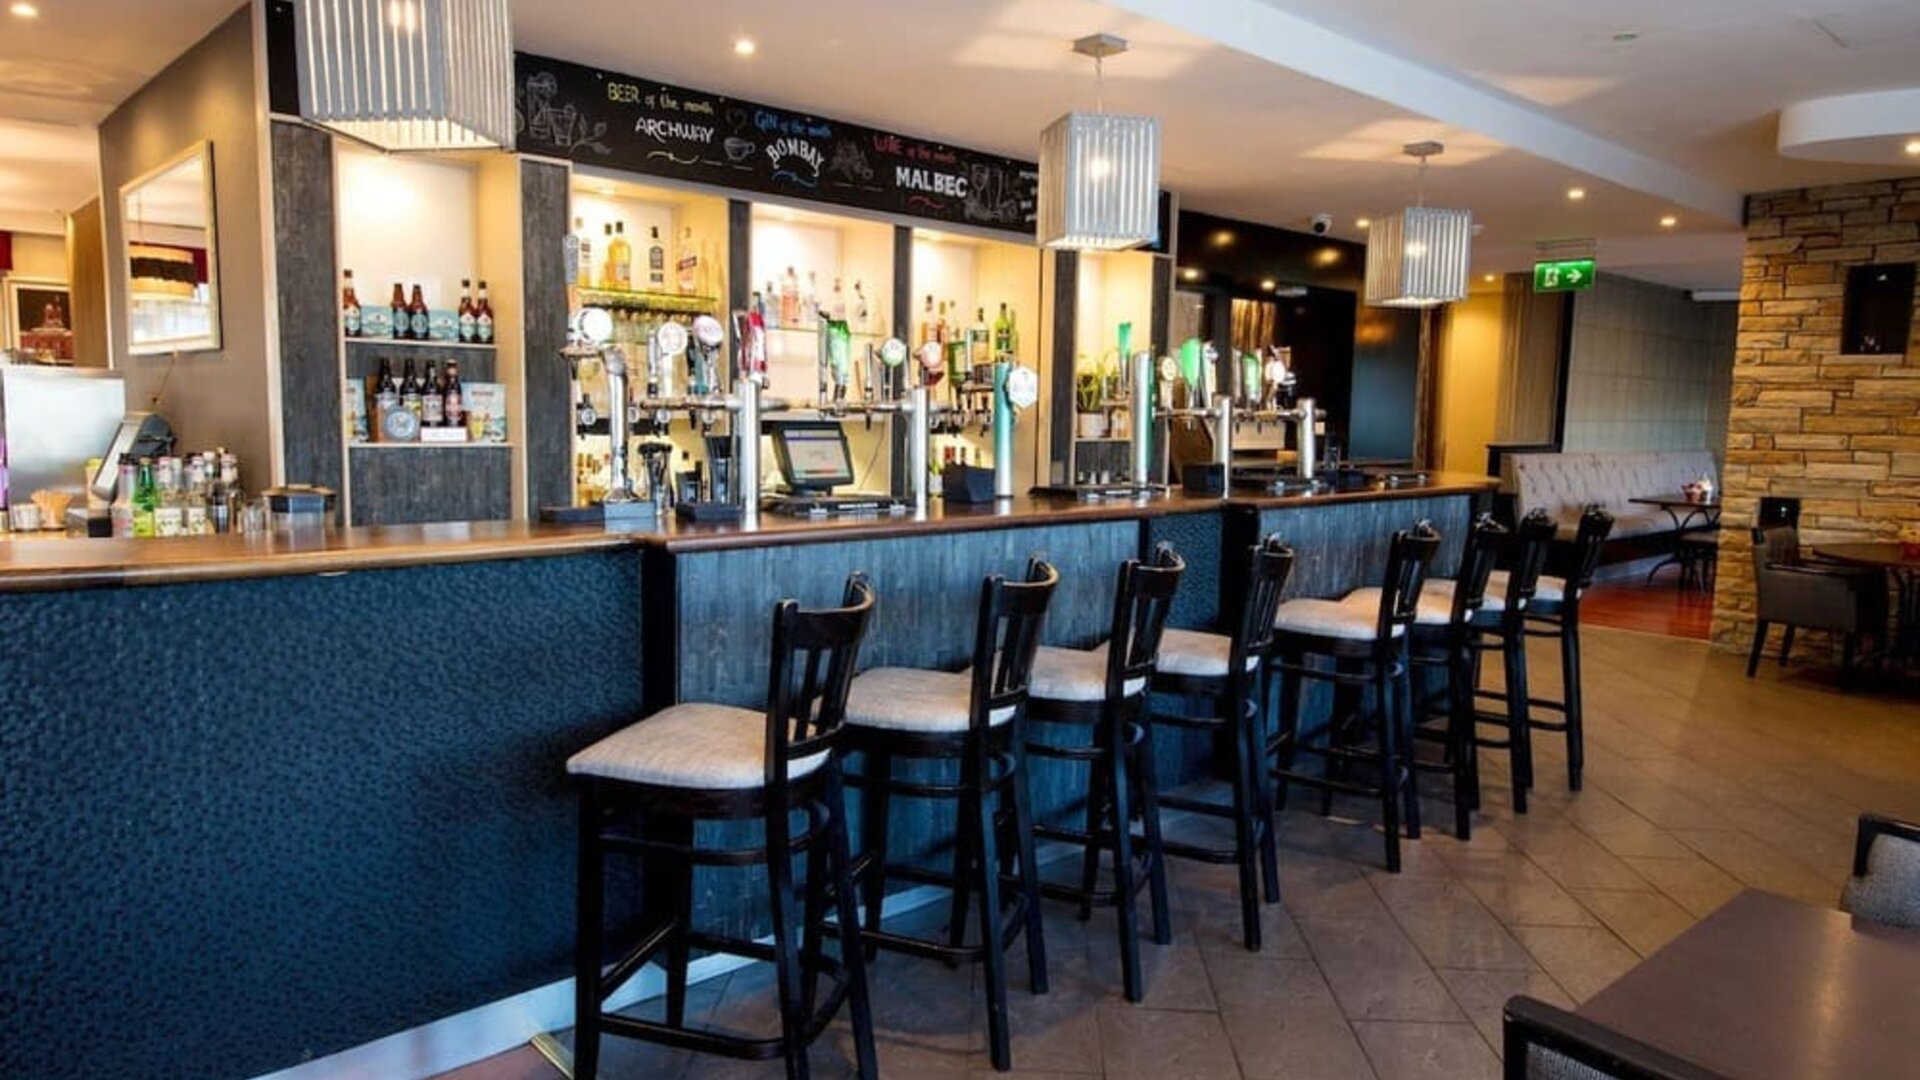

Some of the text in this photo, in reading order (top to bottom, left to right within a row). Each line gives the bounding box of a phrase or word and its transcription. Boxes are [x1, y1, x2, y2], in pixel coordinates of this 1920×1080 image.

[608, 82, 640, 103] BEER
[645, 95, 656, 110] of
[660, 93, 679, 110] the
[635, 117, 714, 143] ARCHWAY
[754, 110, 778, 131] GIN
[765, 138, 824, 177] BOMBAY
[896, 166, 968, 198] MALBEC
